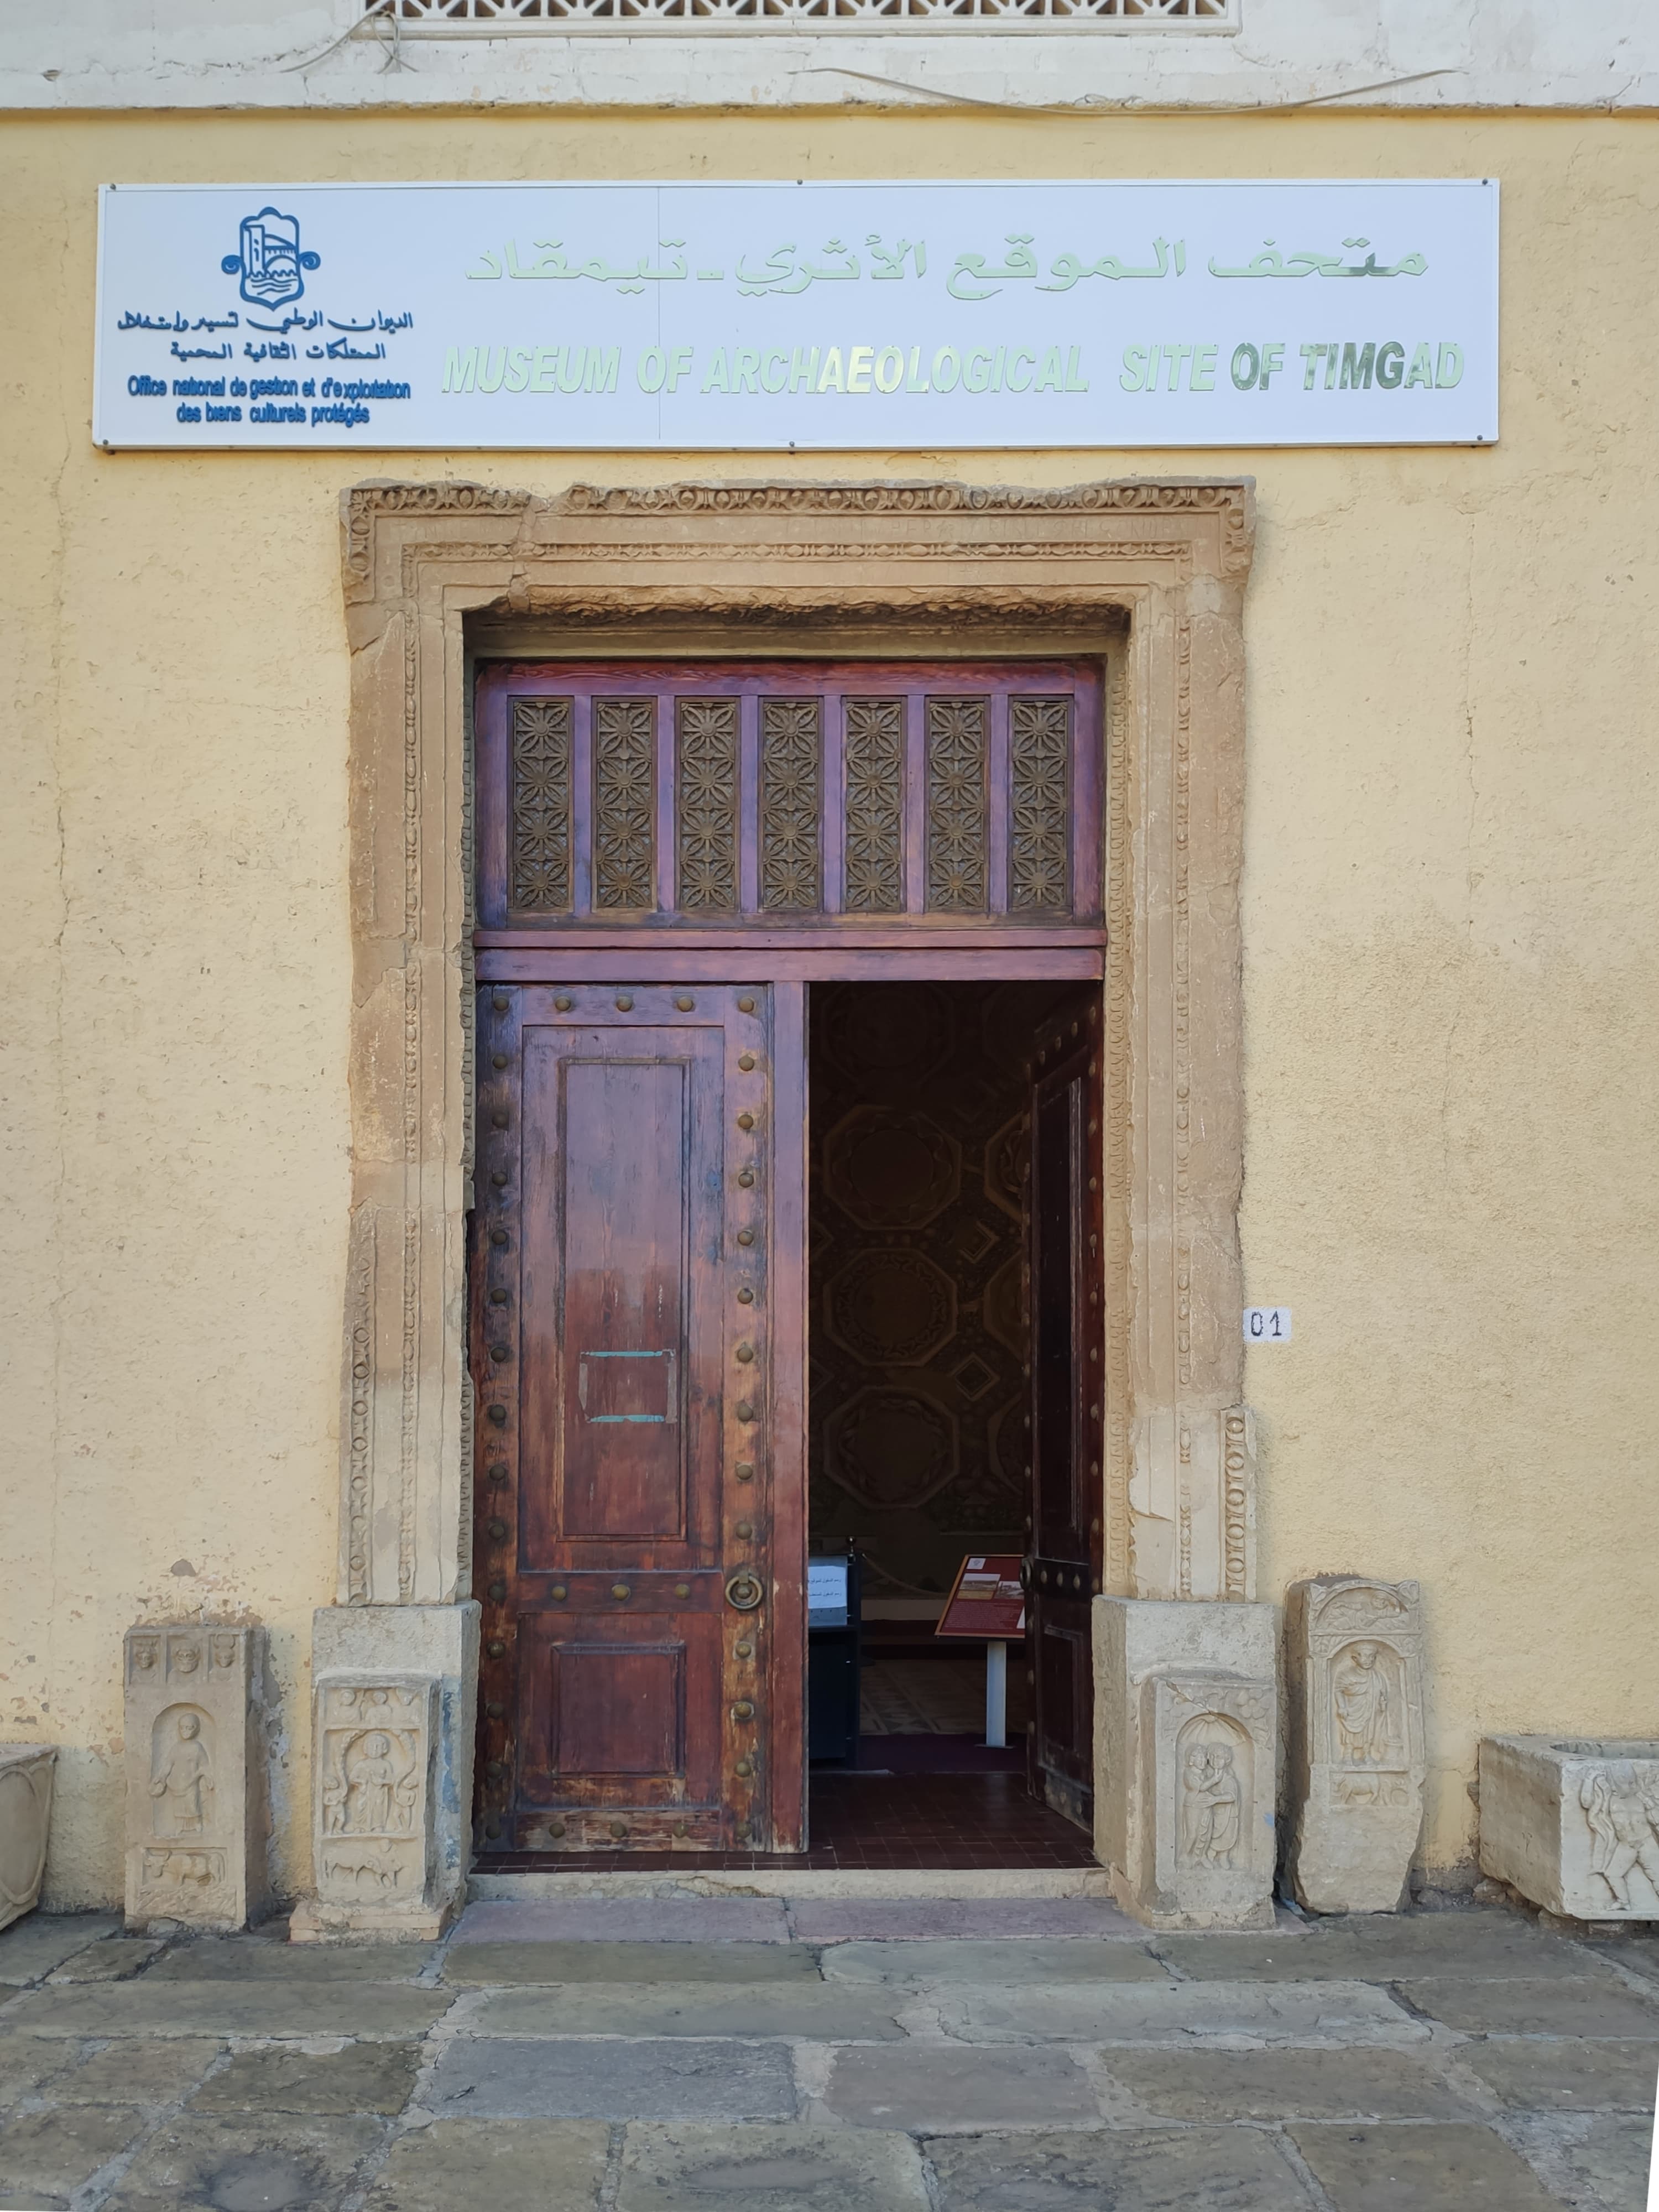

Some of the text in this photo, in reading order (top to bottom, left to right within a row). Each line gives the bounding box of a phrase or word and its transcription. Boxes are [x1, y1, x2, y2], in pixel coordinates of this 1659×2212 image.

[465, 238, 688, 294] تيمقاد
[945, 232, 1186, 300] الموقع
[1208, 236, 1428, 278] متحف
[327, 309, 414, 334] الديوان
[170, 341, 233, 362] المحمية
[441, 341, 1465, 394] MUSEUM OF ARCHAEOLOGICAL SITE OF TIMGAD
[127, 374, 168, 397] Office
[172, 375, 226, 397] national
[229, 375, 248, 397] de
[249, 375, 299, 400] gestion
[301, 377, 316, 398] et
[176, 400, 371, 428] des biens culturels protégés
[1250, 1310, 1282, 1337] 01
